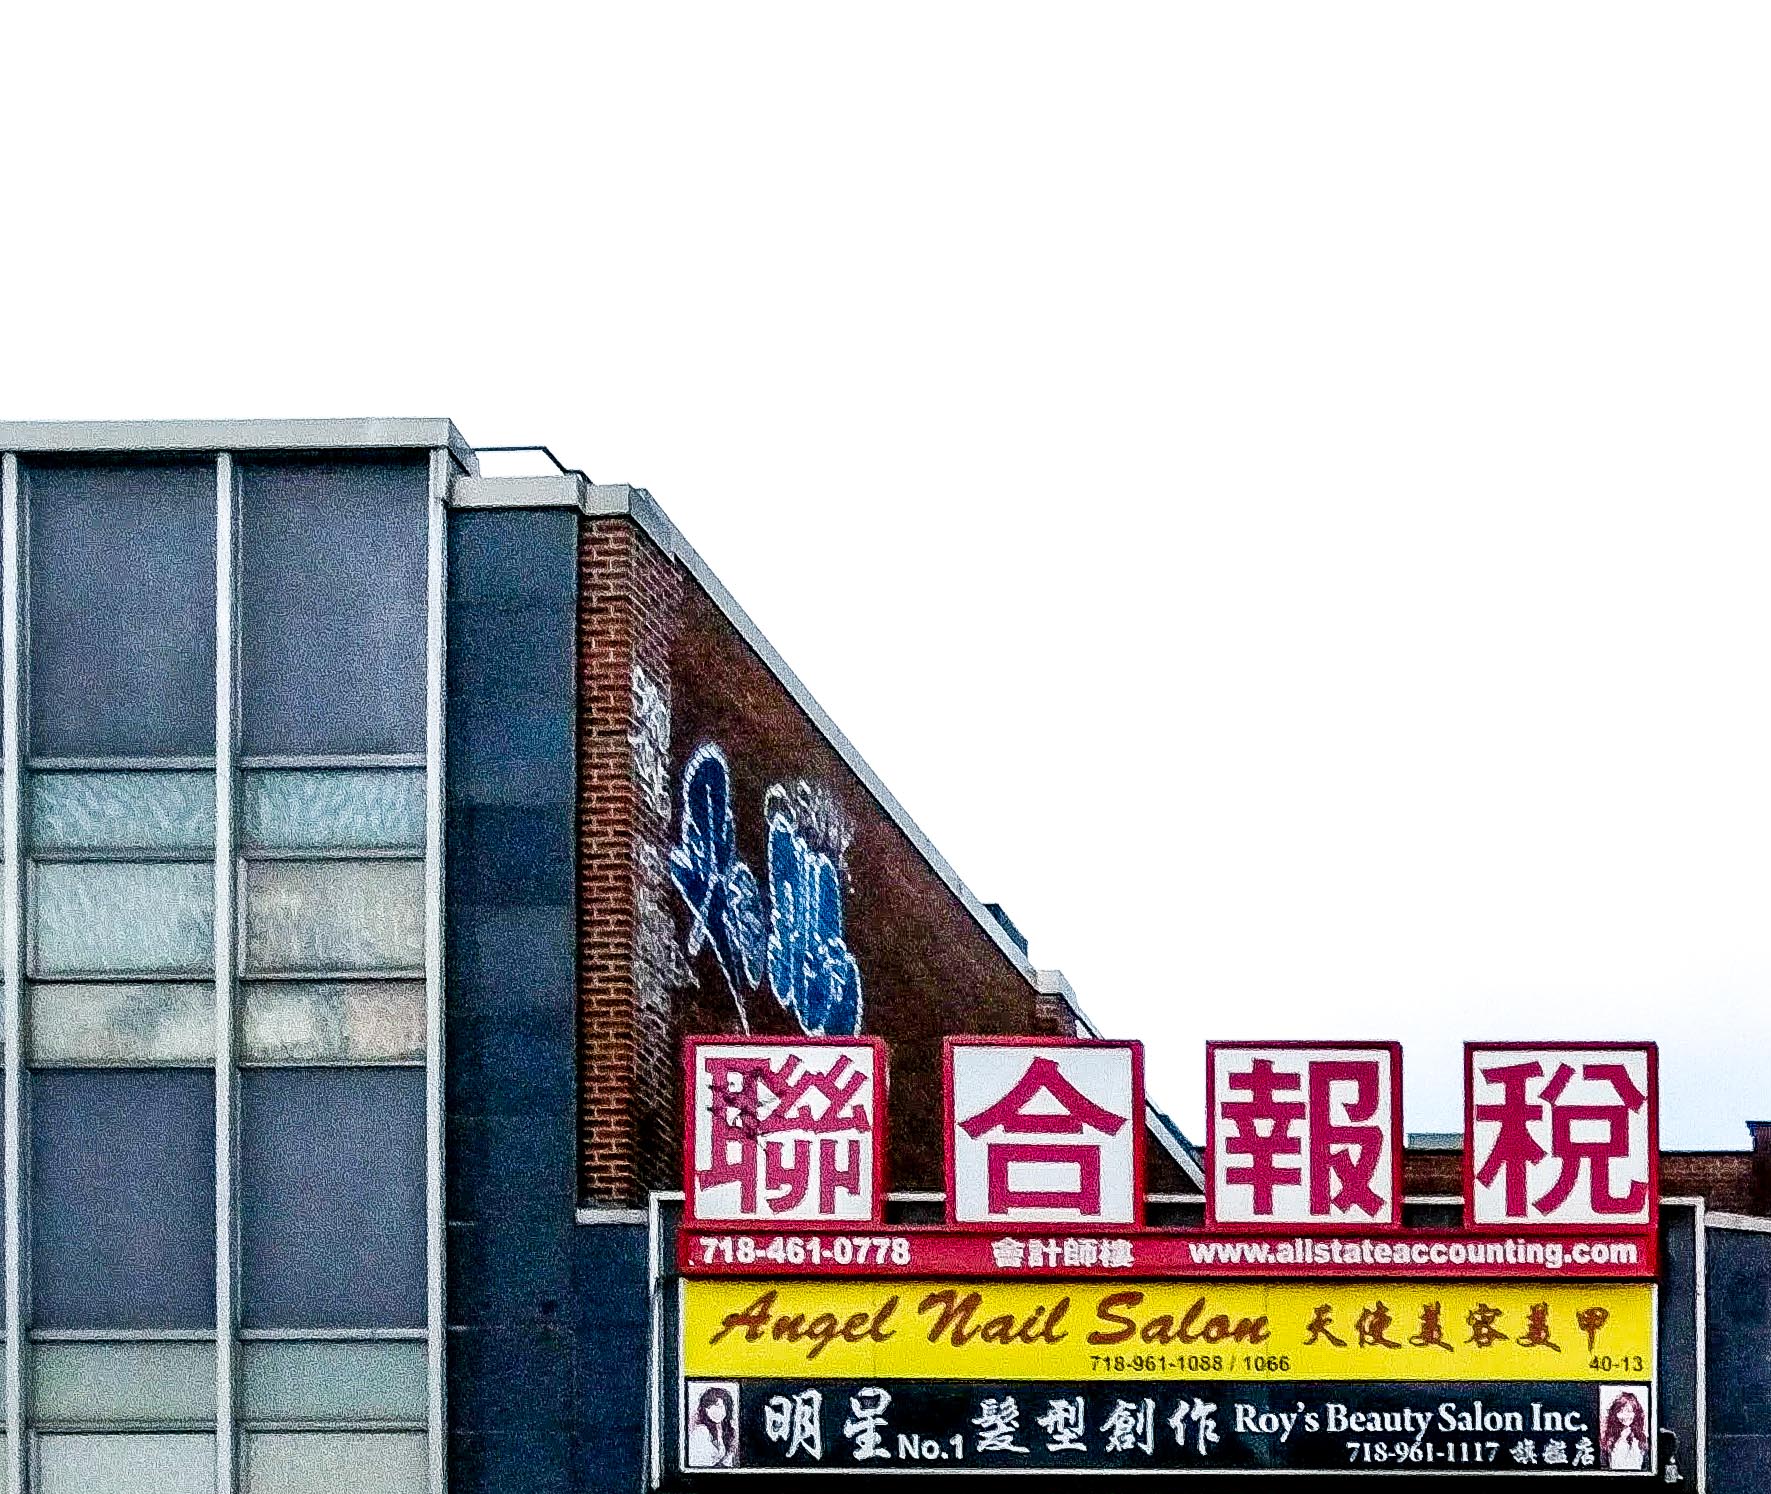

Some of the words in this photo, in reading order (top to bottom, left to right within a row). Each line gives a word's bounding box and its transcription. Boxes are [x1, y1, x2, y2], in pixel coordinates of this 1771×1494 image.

[699, 1054, 1648, 1218] 聯合報稅
[703, 1237, 910, 1266] 718-461-0778
[1188, 1239, 1637, 1269] www.allstateaccounting.com
[708, 1289, 900, 1359] Angel
[917, 1289, 1069, 1348] Nail
[1087, 1290, 1271, 1347] Salon
[1589, 1356, 1644, 1373] 40-13
[763, 1387, 893, 1460] 明星
[1234, 1402, 1320, 1443] Roy's
[1327, 1402, 1433, 1443] Beauty
[1437, 1402, 1529, 1432] Salon
[1533, 1403, 1588, 1432] Inc.
[898, 1433, 964, 1459] No.1
[1347, 1441, 1500, 1463] 718-961-1117
